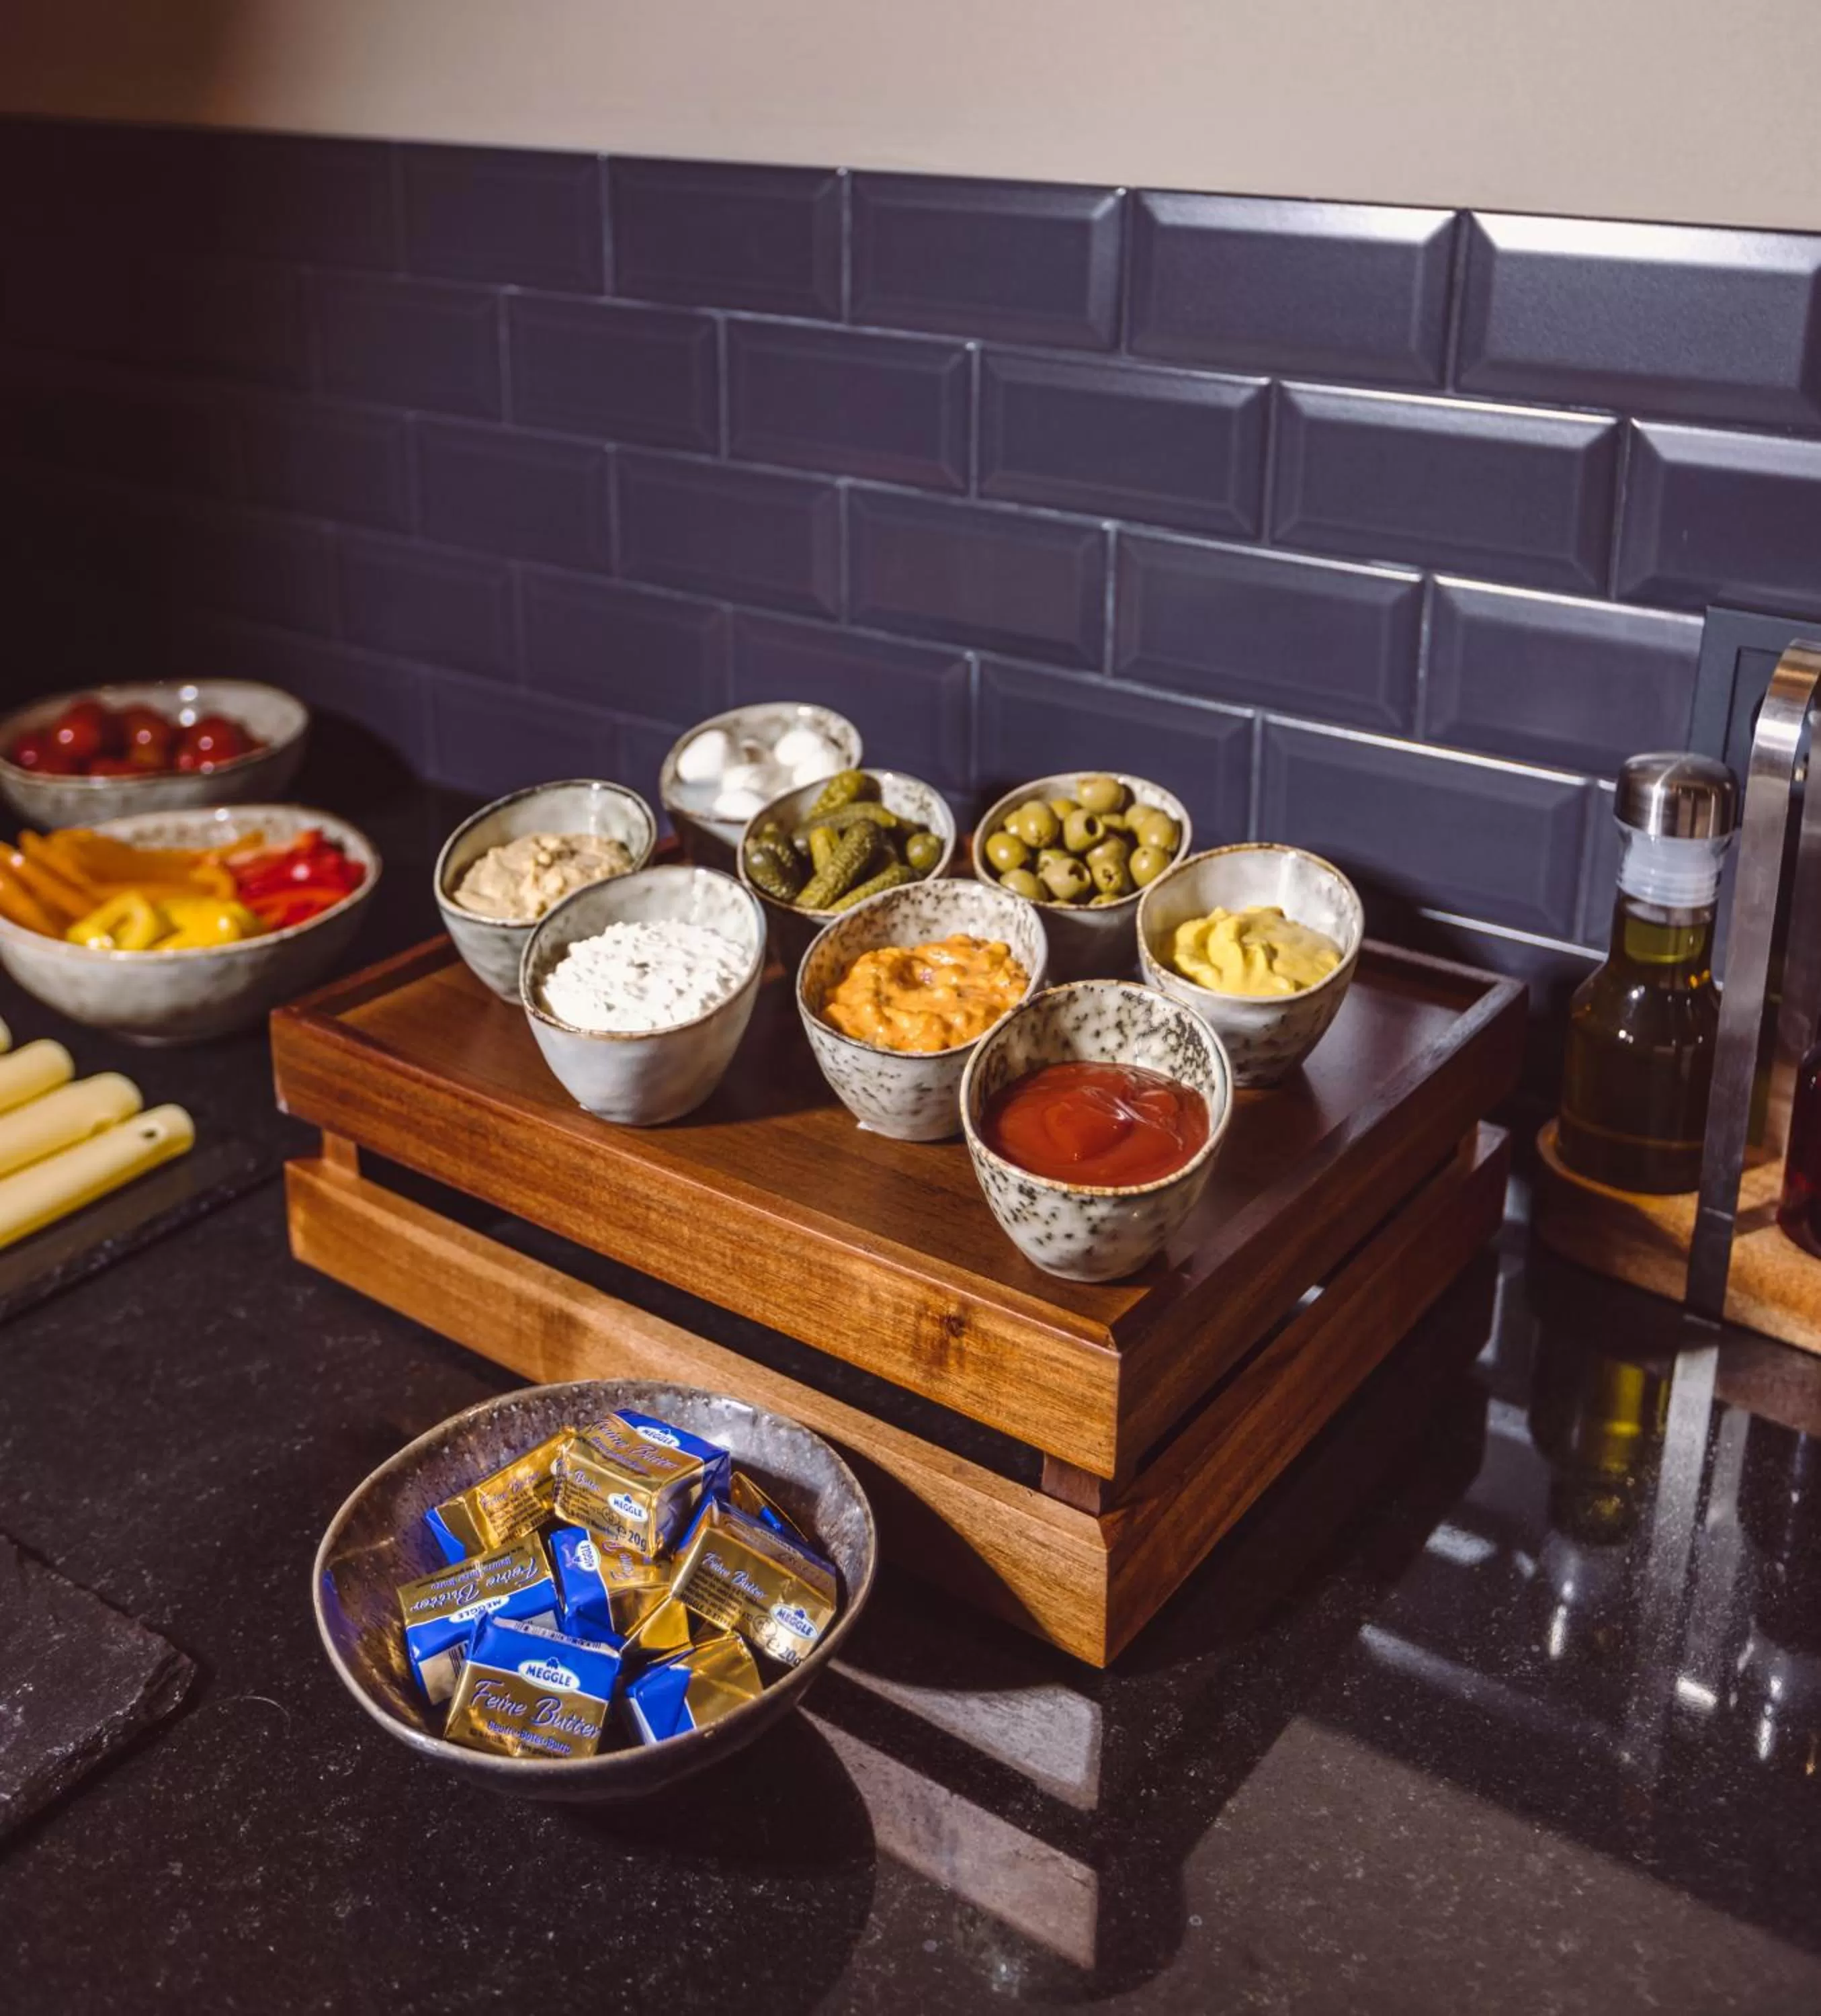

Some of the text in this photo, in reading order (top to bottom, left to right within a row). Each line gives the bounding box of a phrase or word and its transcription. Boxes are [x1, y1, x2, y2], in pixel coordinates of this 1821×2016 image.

[642, 1427, 674, 1445] MEGGLE
[613, 1497, 643, 1519] MEGGLE
[628, 1529, 647, 1552] 20g
[485, 1556, 538, 1587] Feine
[410, 1582, 480, 1613] Butter
[777, 1609, 814, 1636] MEGGLE
[525, 1664, 573, 1687] MEGGLE
[471, 1679, 603, 1740] Feine Butter
